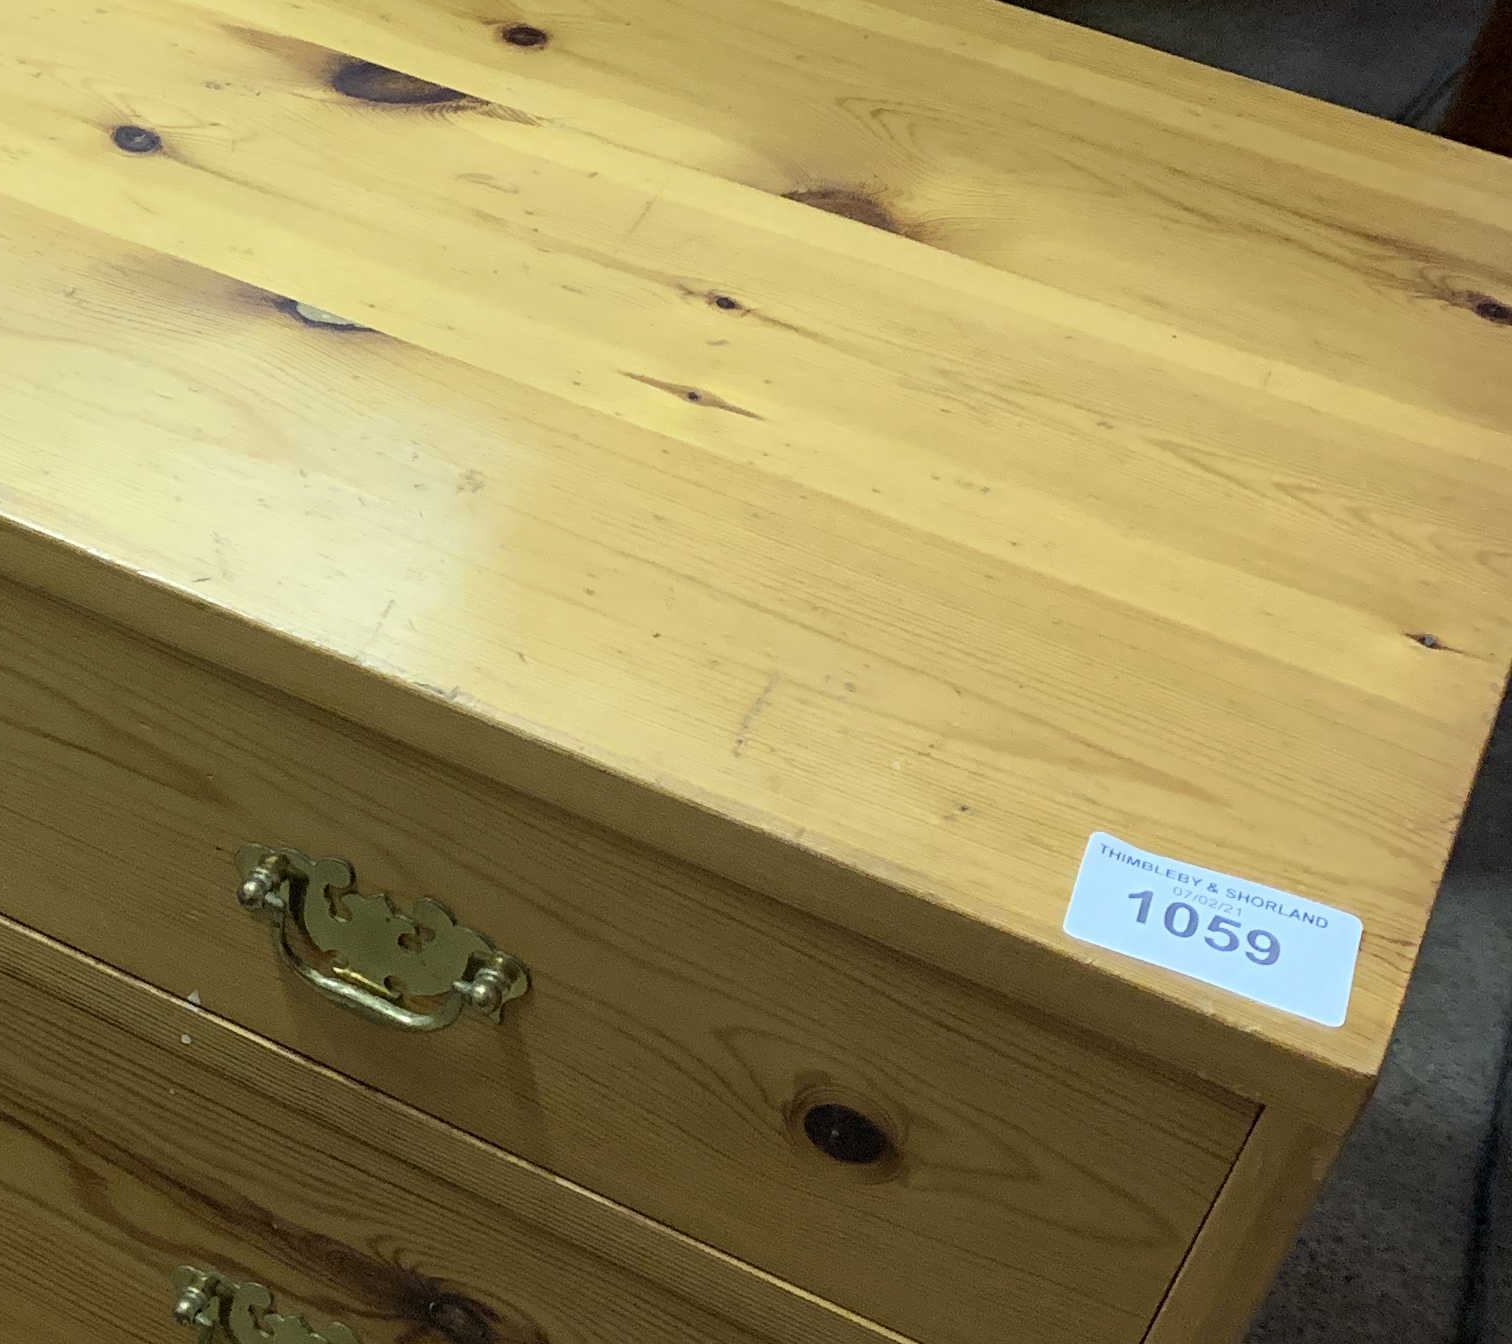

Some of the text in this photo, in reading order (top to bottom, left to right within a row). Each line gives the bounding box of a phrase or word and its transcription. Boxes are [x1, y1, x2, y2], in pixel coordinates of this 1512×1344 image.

[1099, 842, 1329, 929] THIMBLEBY & SHORLAND
[1172, 885, 1243, 917] 07/02/21
[1127, 889, 1281, 966] 1059
